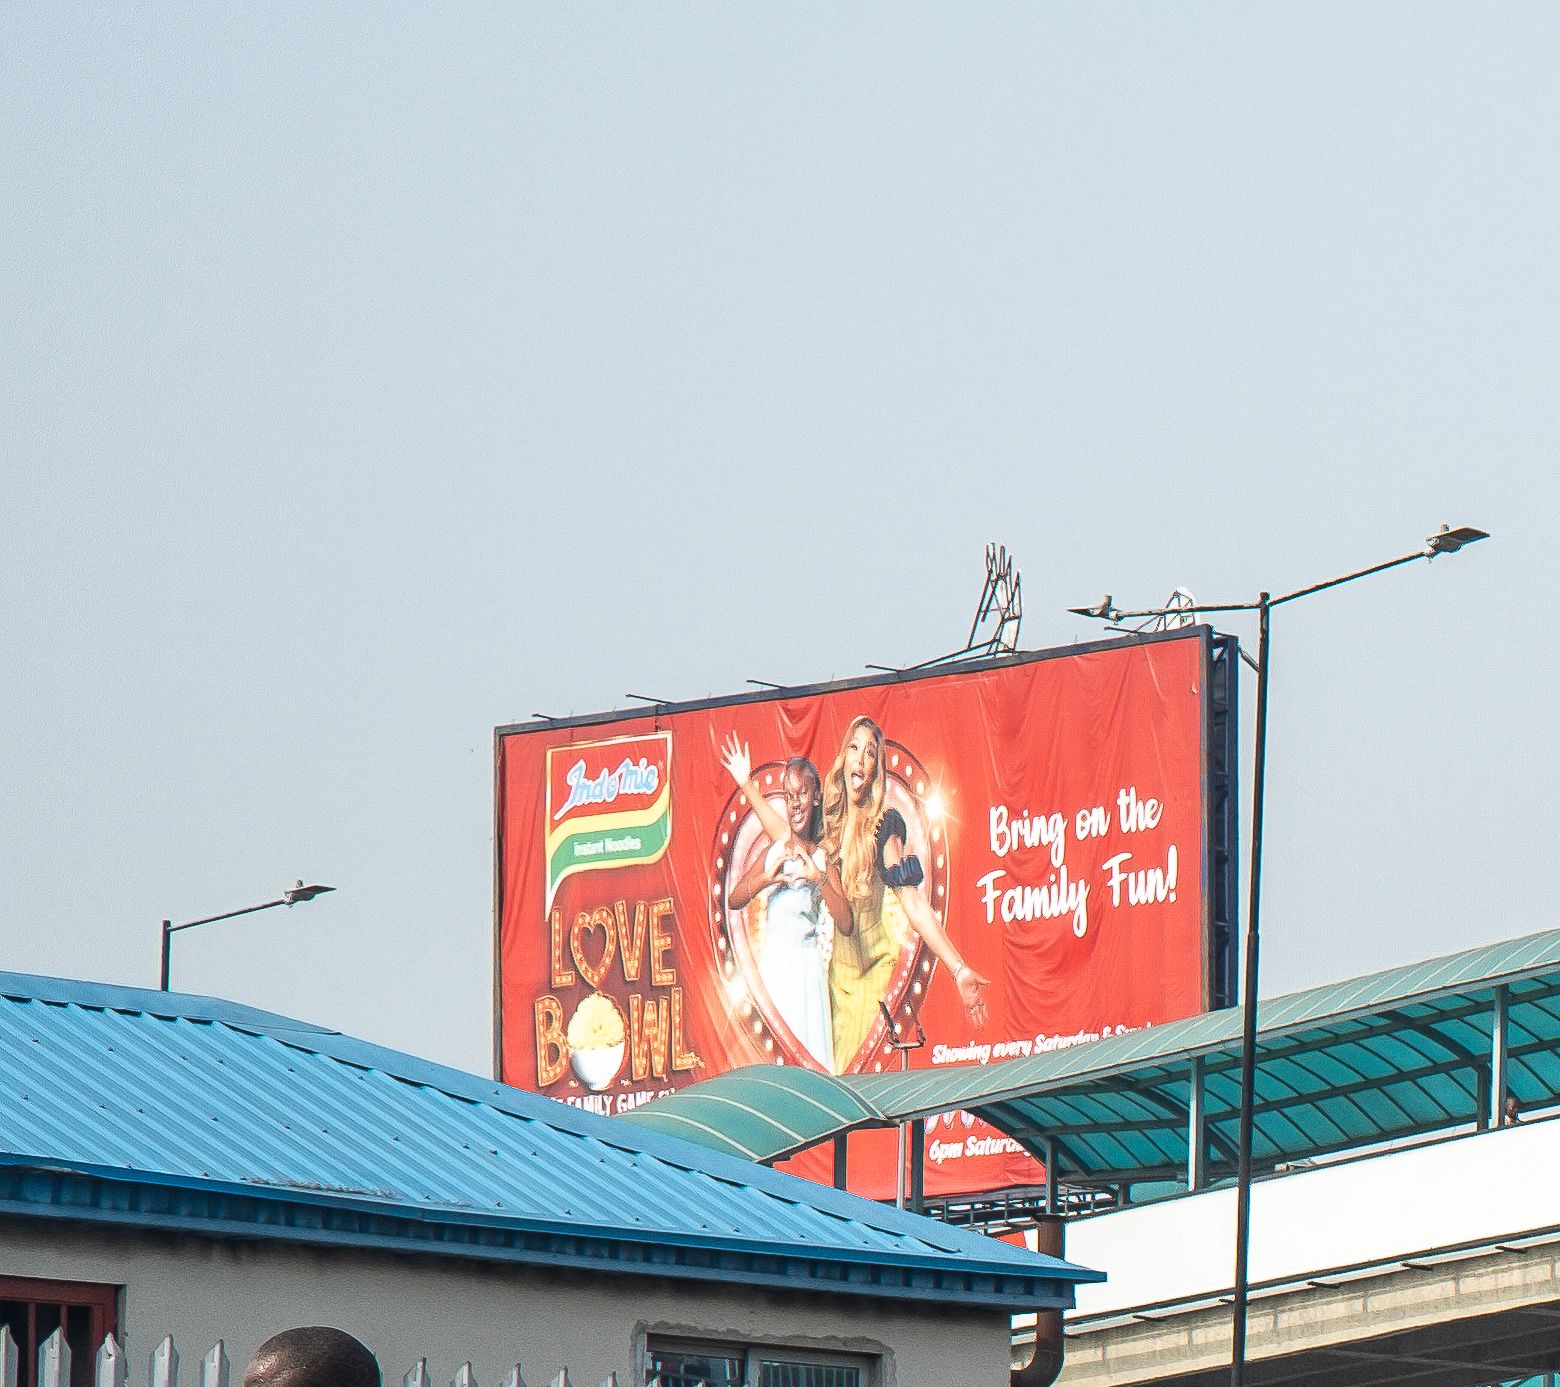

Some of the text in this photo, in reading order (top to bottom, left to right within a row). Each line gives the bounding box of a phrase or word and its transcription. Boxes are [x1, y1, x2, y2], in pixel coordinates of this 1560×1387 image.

[988, 785, 1164, 869] Bring on the
[976, 843, 1179, 939] Family Fun!
[931, 1040, 992, 1066] Showing
[992, 1038, 1033, 1058] every
[928, 1138, 964, 1165] 6pm
